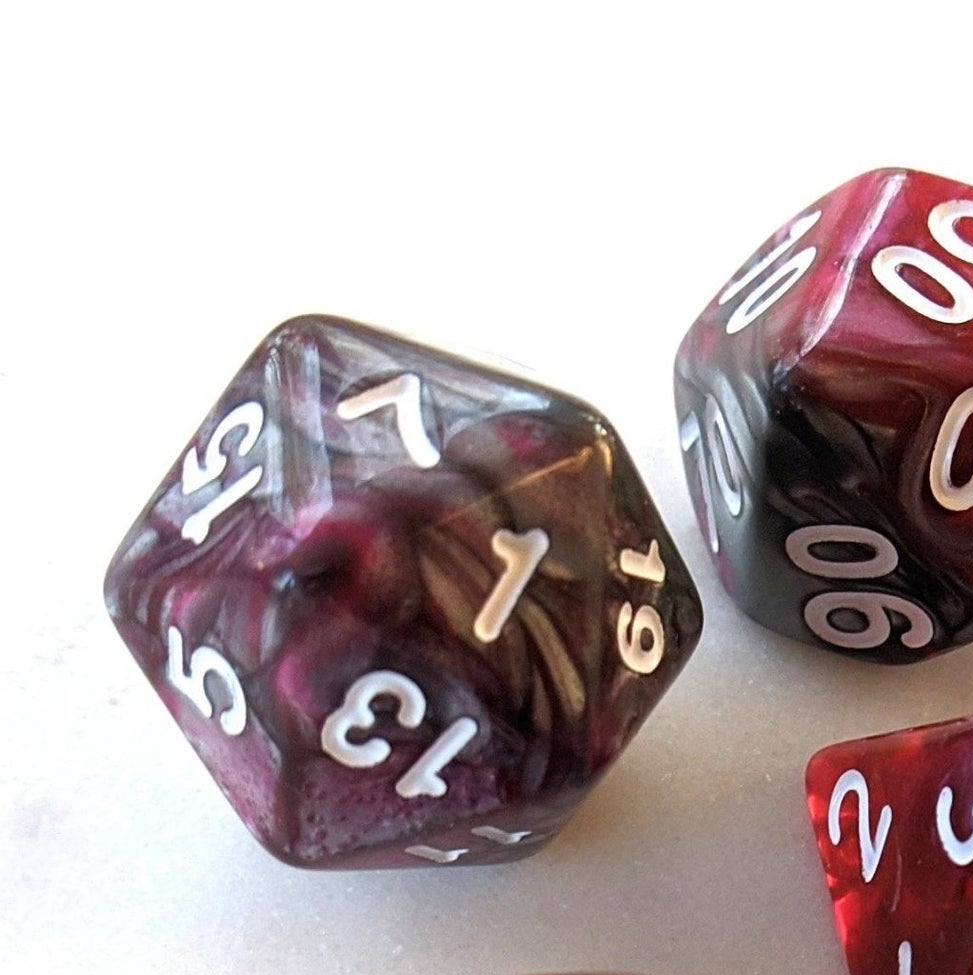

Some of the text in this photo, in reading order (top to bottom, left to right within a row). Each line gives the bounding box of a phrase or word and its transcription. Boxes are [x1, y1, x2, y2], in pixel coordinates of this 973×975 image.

[182, 400, 265, 544] 15
[336, 373, 440, 468] 7
[473, 528, 550, 643] 1
[168, 625, 247, 736] 5
[321, 670, 478, 799] 13
[828, 768, 893, 883] 2
